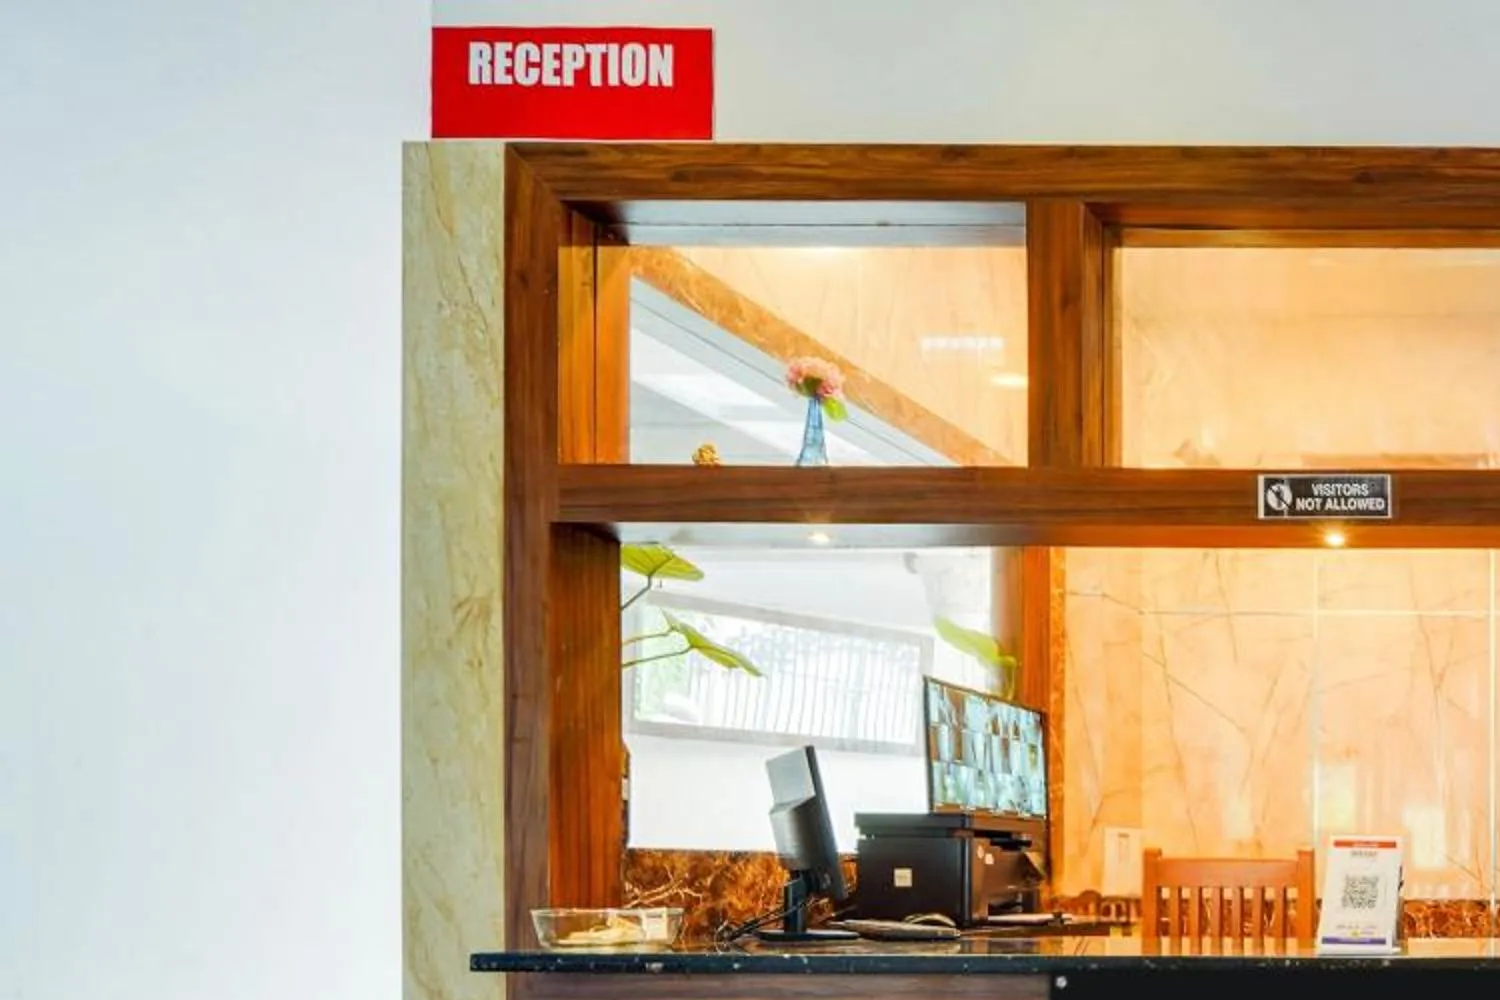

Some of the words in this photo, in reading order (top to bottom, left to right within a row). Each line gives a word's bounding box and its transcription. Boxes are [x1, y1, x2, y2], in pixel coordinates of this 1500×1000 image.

[468, 41, 675, 88] RECEPTION
[1311, 483, 1370, 497] VISITORS
[1296, 498, 1321, 511] NOT
[1325, 497, 1386, 511] ALLOWED
